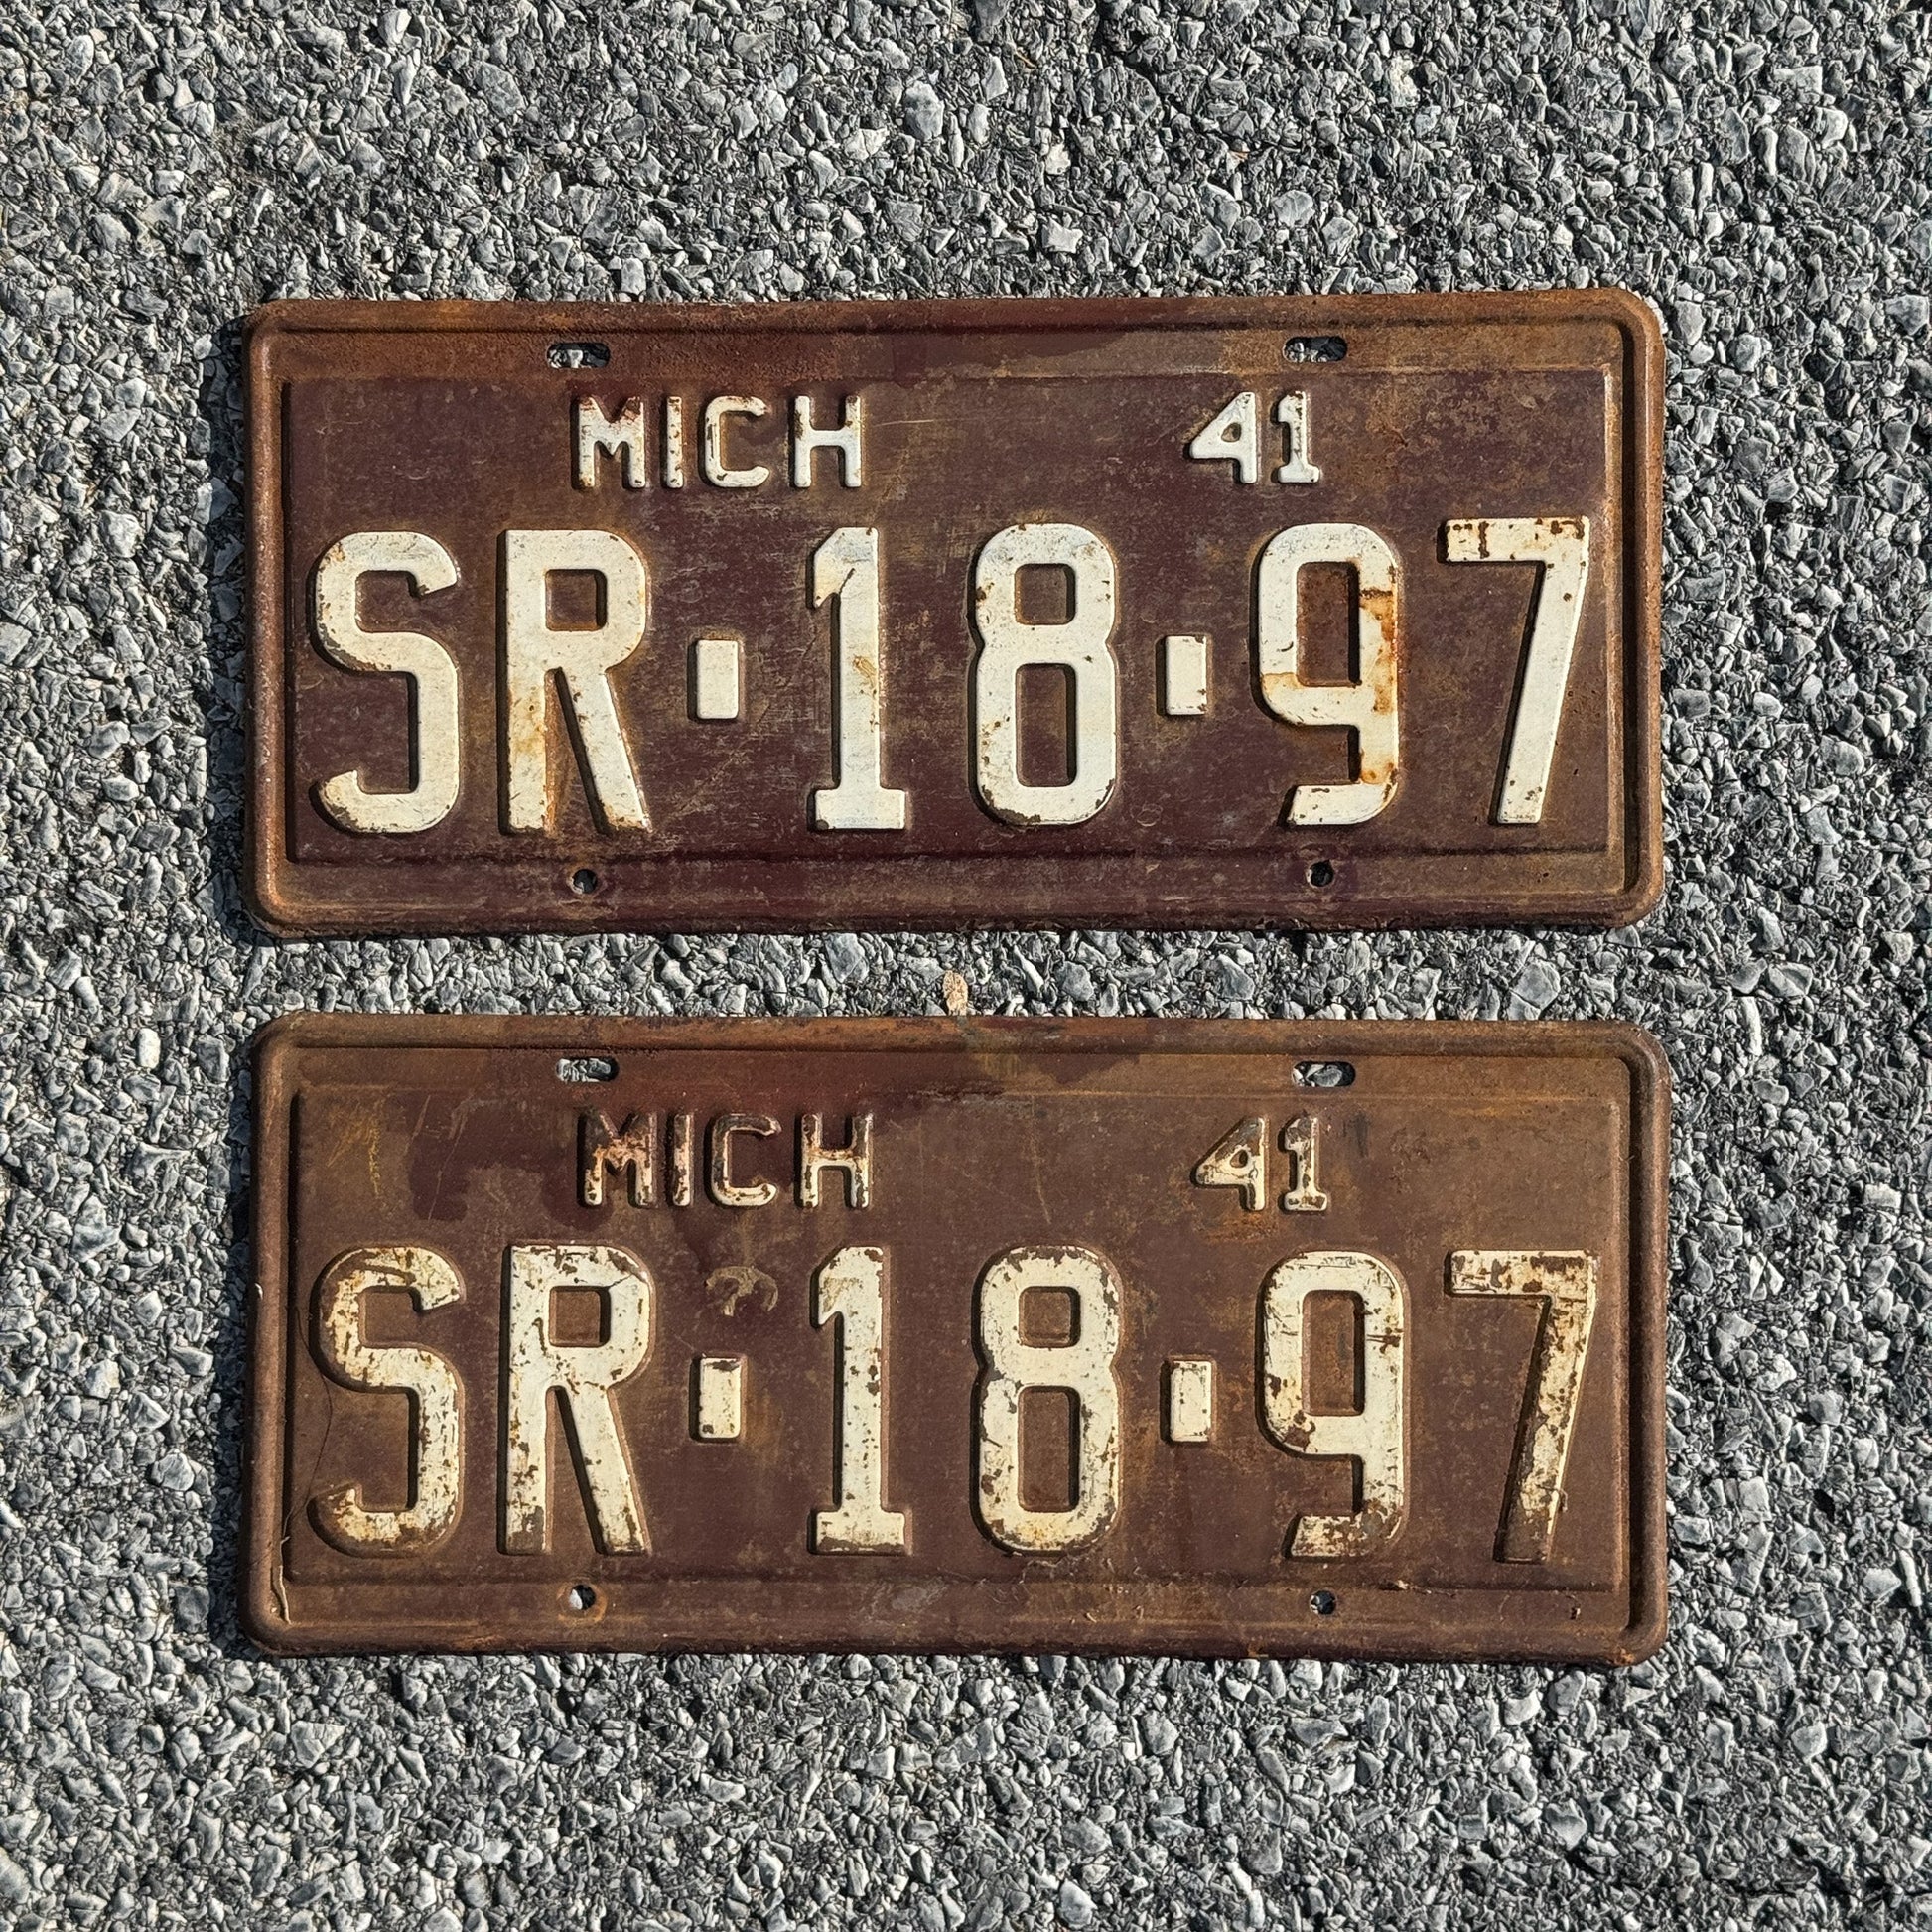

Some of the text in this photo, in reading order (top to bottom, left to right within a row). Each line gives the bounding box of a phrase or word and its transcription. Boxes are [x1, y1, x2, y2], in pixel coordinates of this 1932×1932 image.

[578, 391, 1320, 489] MICH 41
[583, 1113, 1328, 1211] MICH 41
